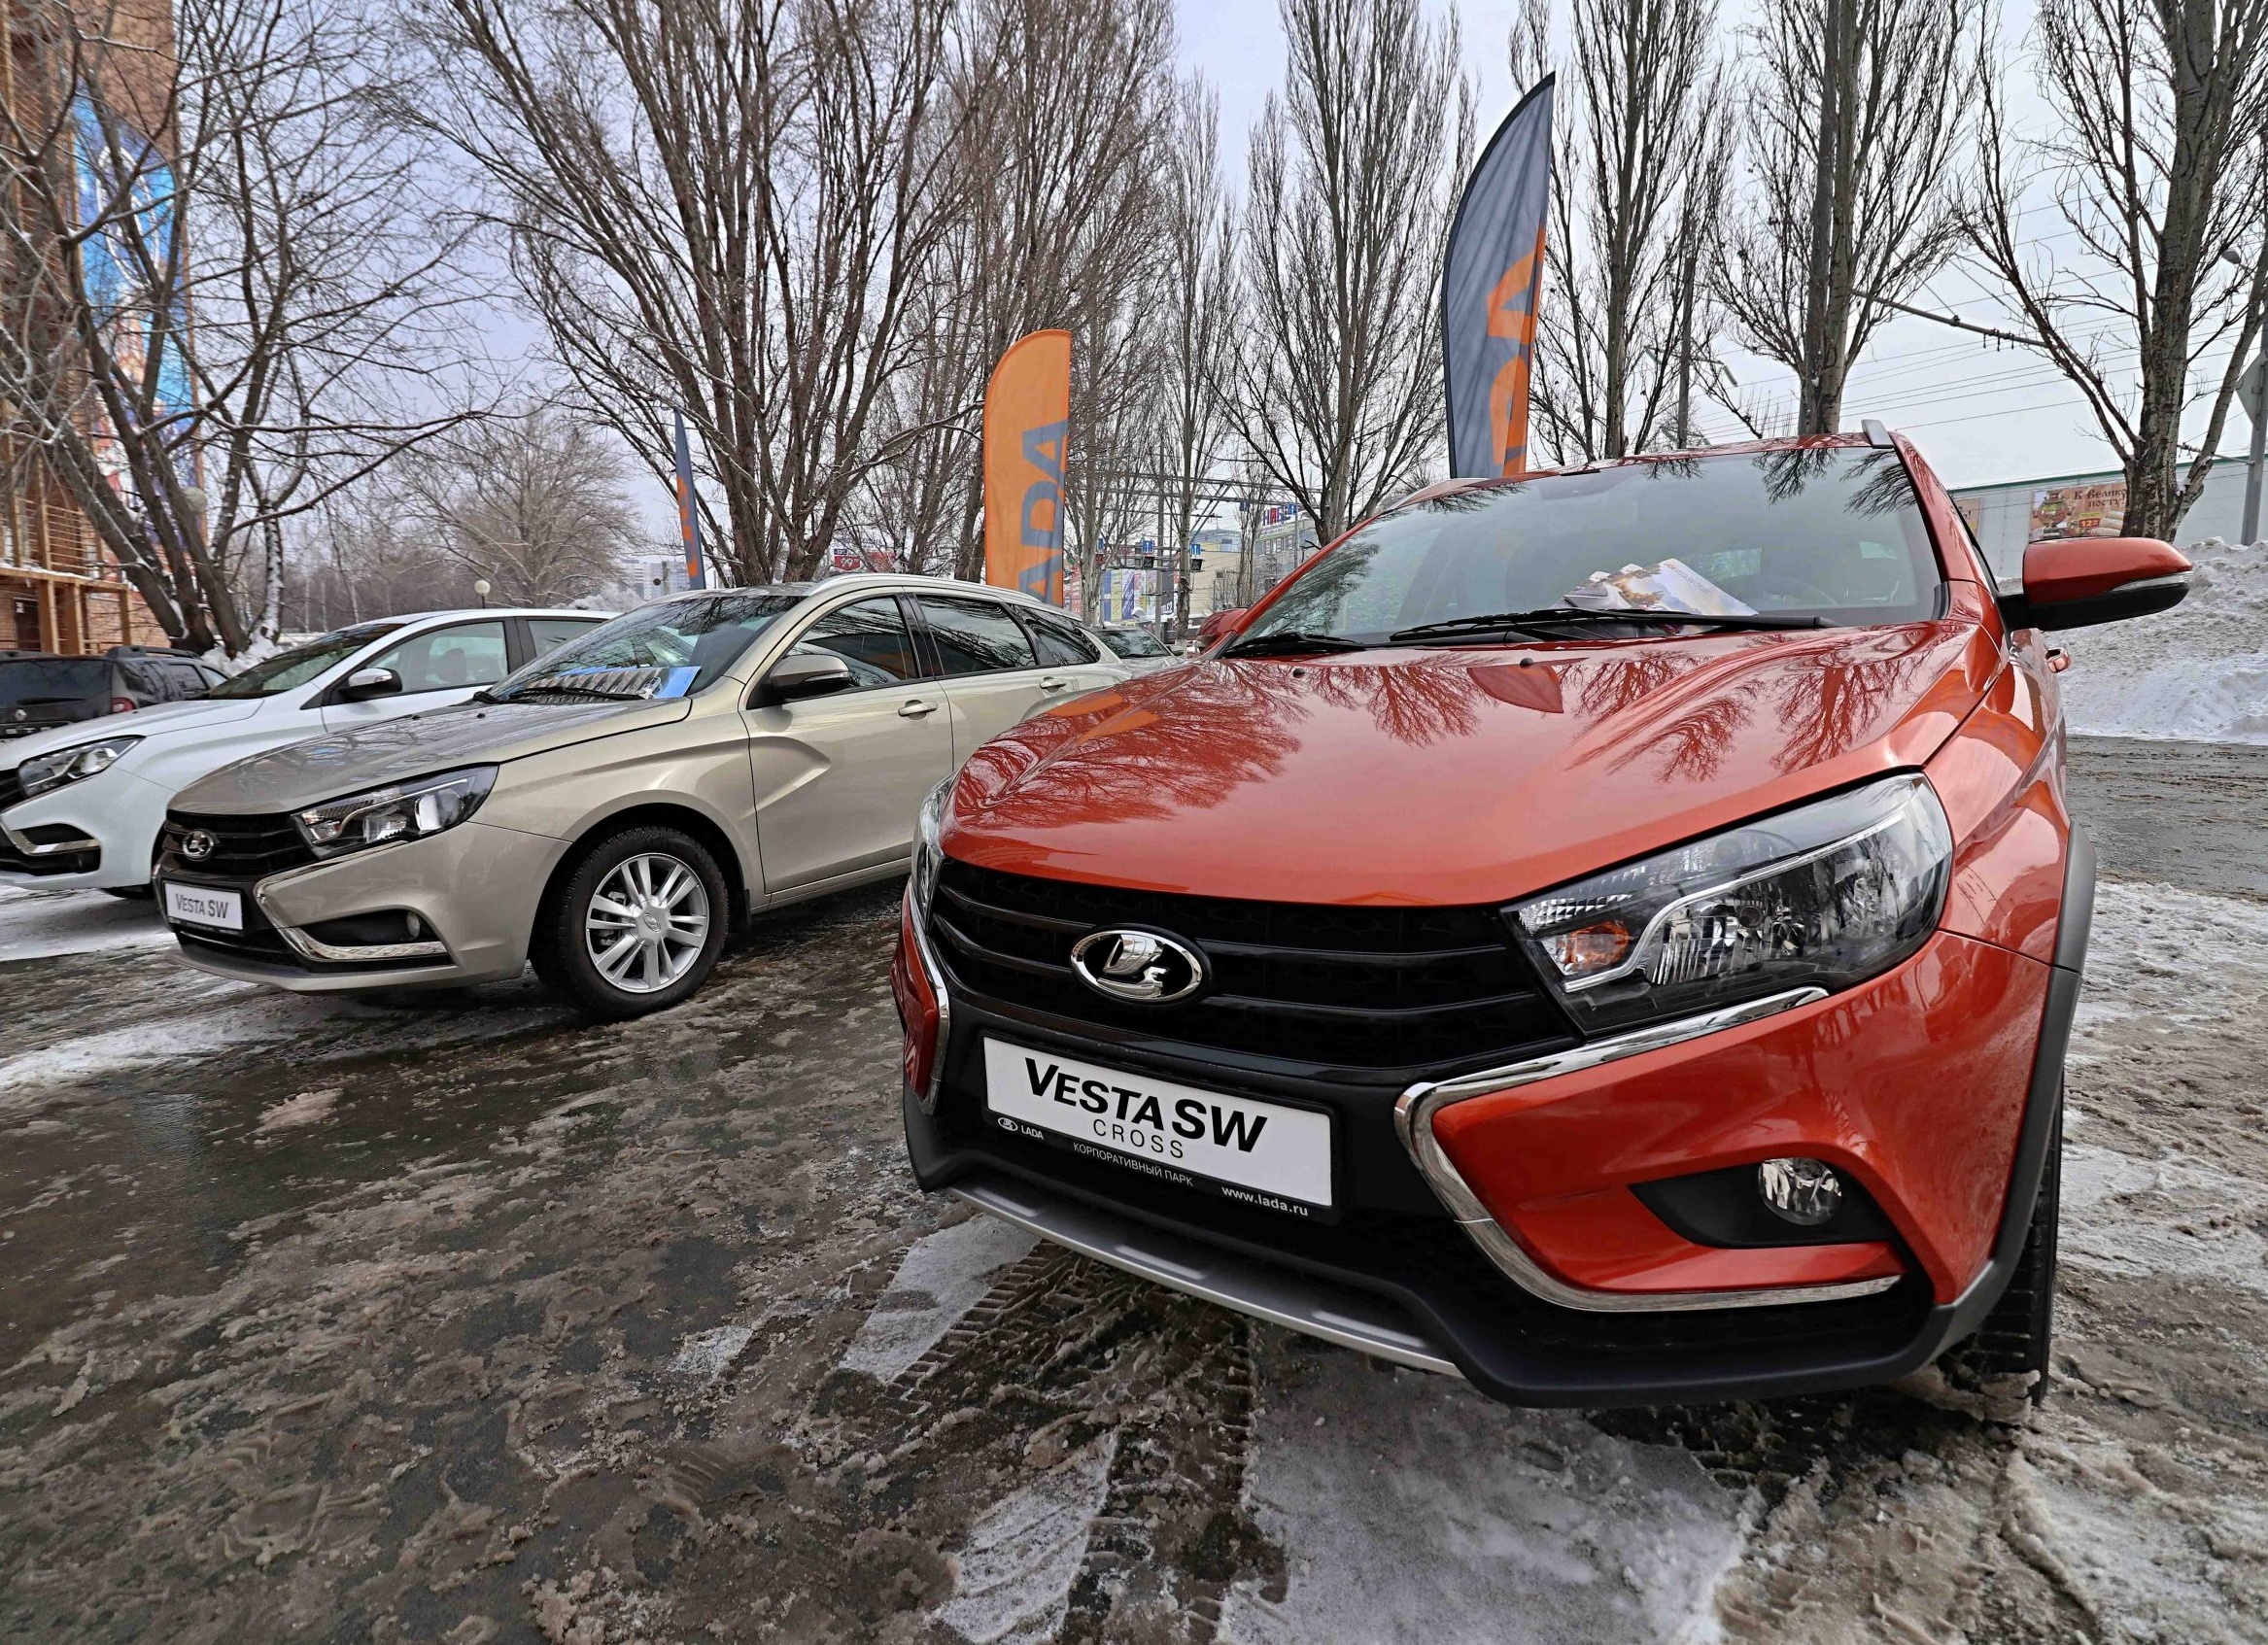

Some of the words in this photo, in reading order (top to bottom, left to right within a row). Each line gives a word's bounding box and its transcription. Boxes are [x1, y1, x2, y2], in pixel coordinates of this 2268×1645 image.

[175, 893, 206, 915] VESTA
[208, 899, 229, 919] SW
[1024, 1057, 1165, 1131] VESTA
[1172, 1098, 1268, 1153] SW
[1020, 1124, 1045, 1141] LADA
[1092, 1118, 1185, 1159] CROSS
[1073, 1142, 1163, 1179] КОРПОРАТИВНЫЙ
[1164, 1168, 1194, 1187] ПАРК
[1221, 1185, 1309, 1217] www.lada.ru
